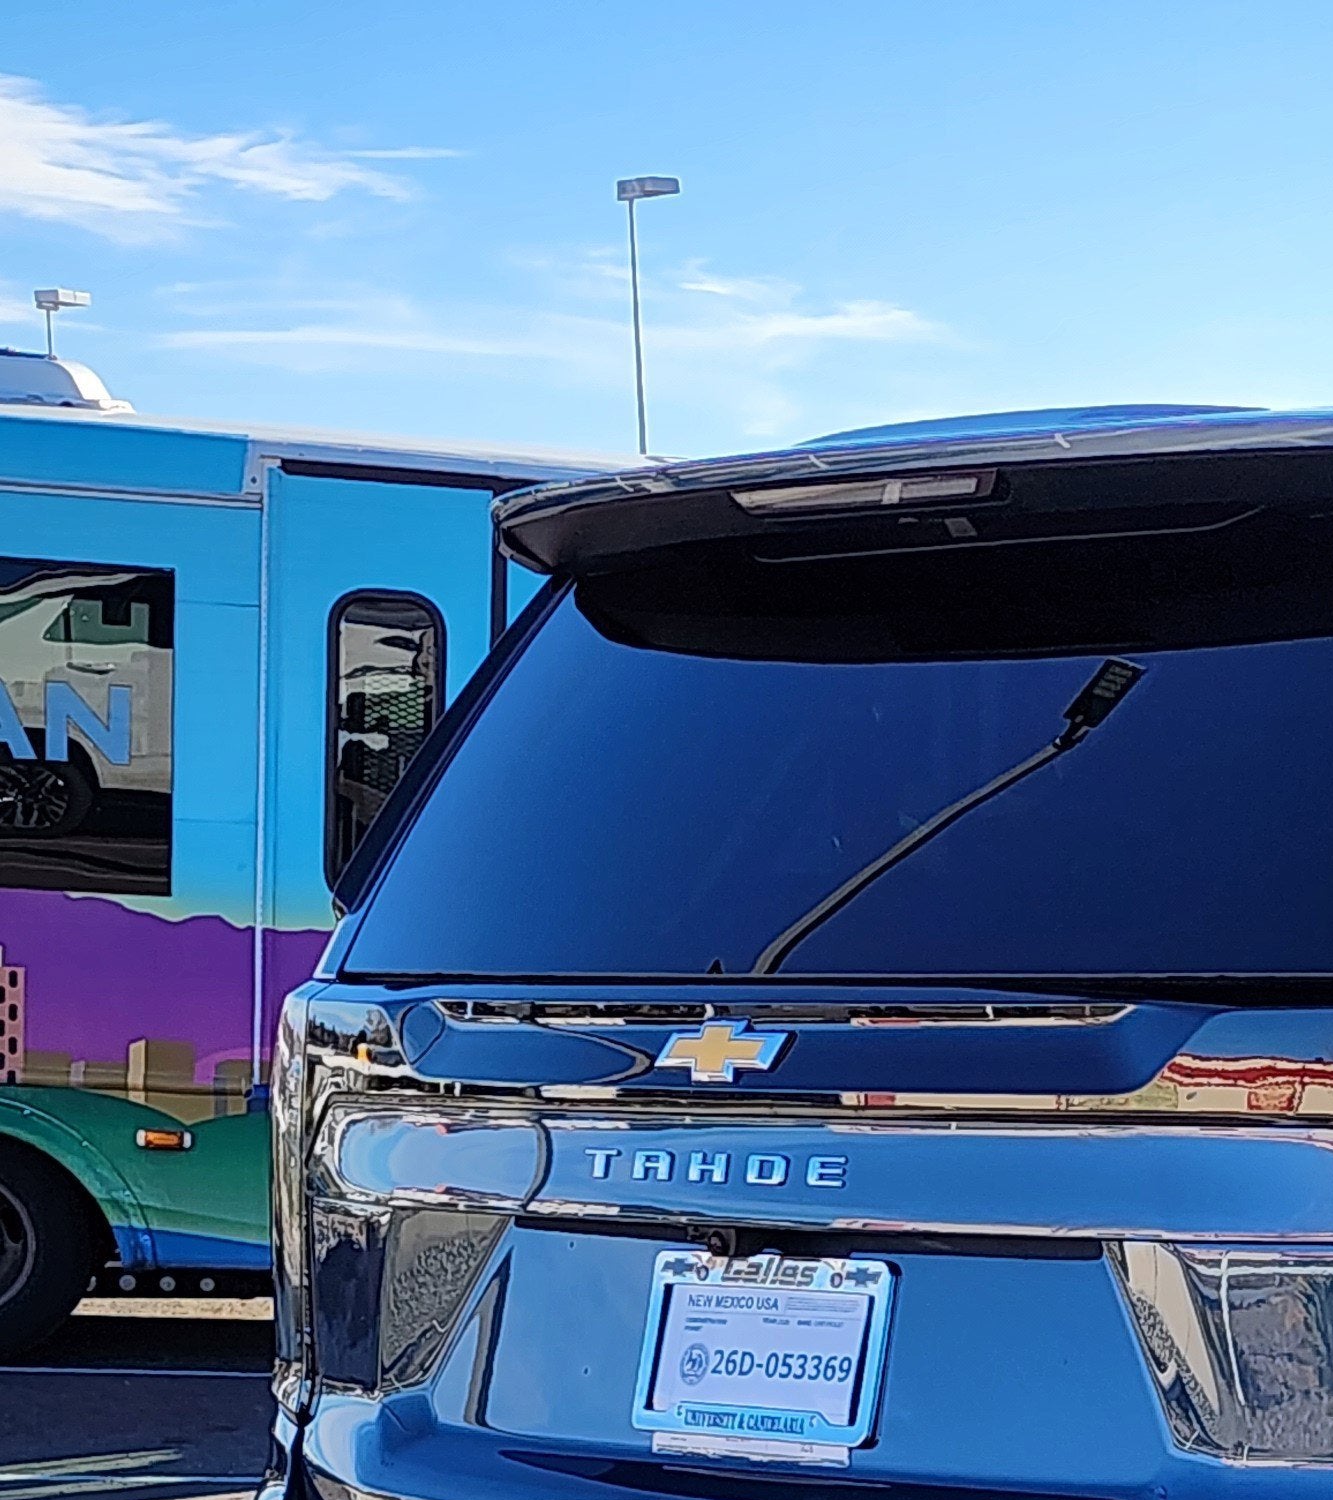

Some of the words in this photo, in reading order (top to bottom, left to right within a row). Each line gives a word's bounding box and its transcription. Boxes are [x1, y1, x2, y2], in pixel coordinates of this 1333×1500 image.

[585, 1148, 848, 1189] TAHOE
[688, 1294, 713, 1308] NEW
[714, 1296, 754, 1310] MEXICO
[756, 1297, 779, 1311] USA
[711, 1349, 851, 1383] 26D-053369
